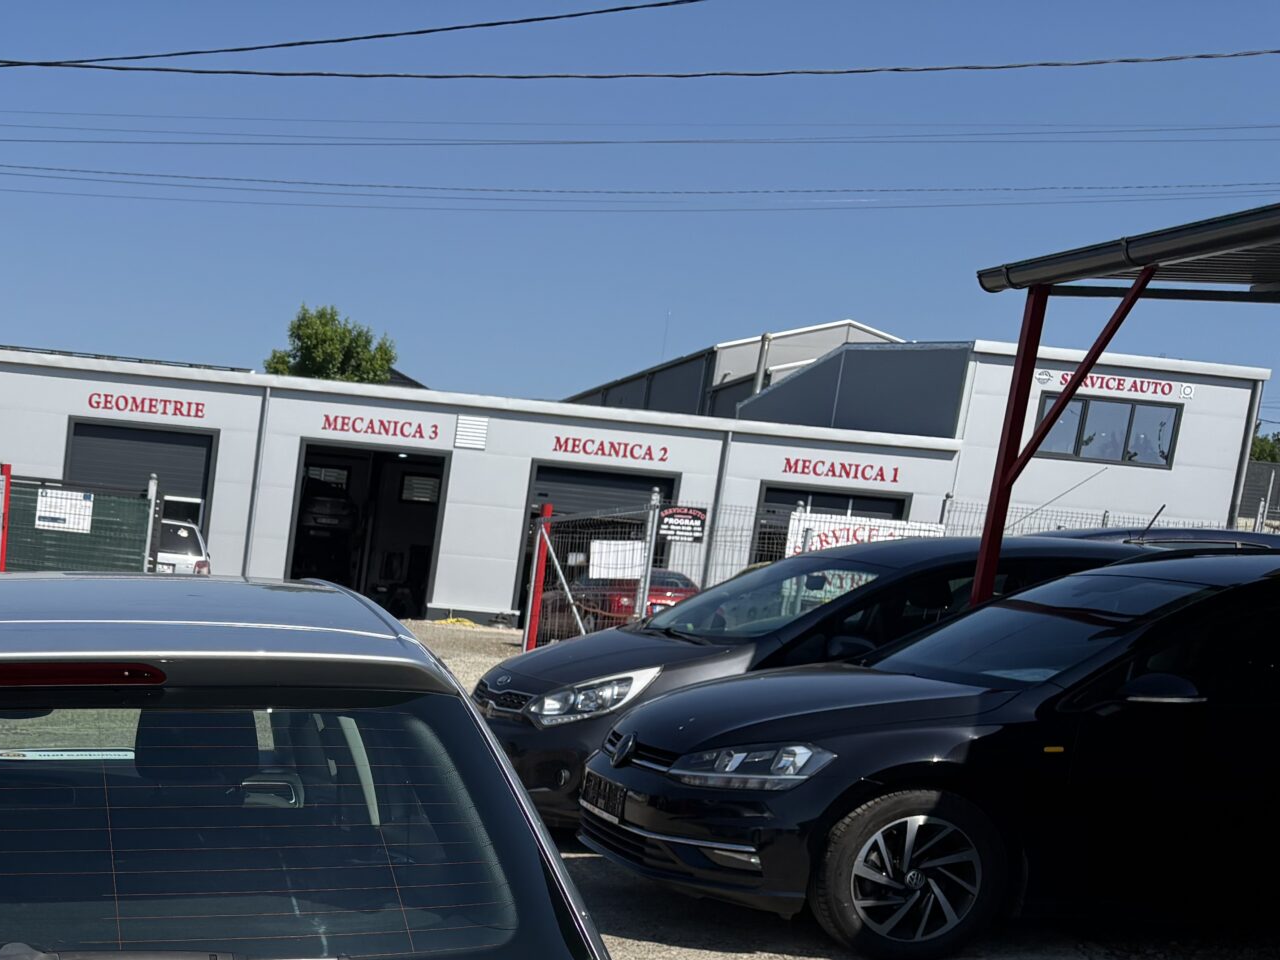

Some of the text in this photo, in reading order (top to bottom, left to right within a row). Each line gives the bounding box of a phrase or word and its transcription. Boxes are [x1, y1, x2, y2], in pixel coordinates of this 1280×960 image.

[1128, 378, 1173, 396] AUTO
[88, 392, 205, 419] GEOMETRIE
[321, 414, 439, 440] MECANICA 3
[552, 436, 669, 462] MECANICA 2
[782, 457, 899, 483] MECANICA 1
[663, 517, 701, 526] PROGRAM
